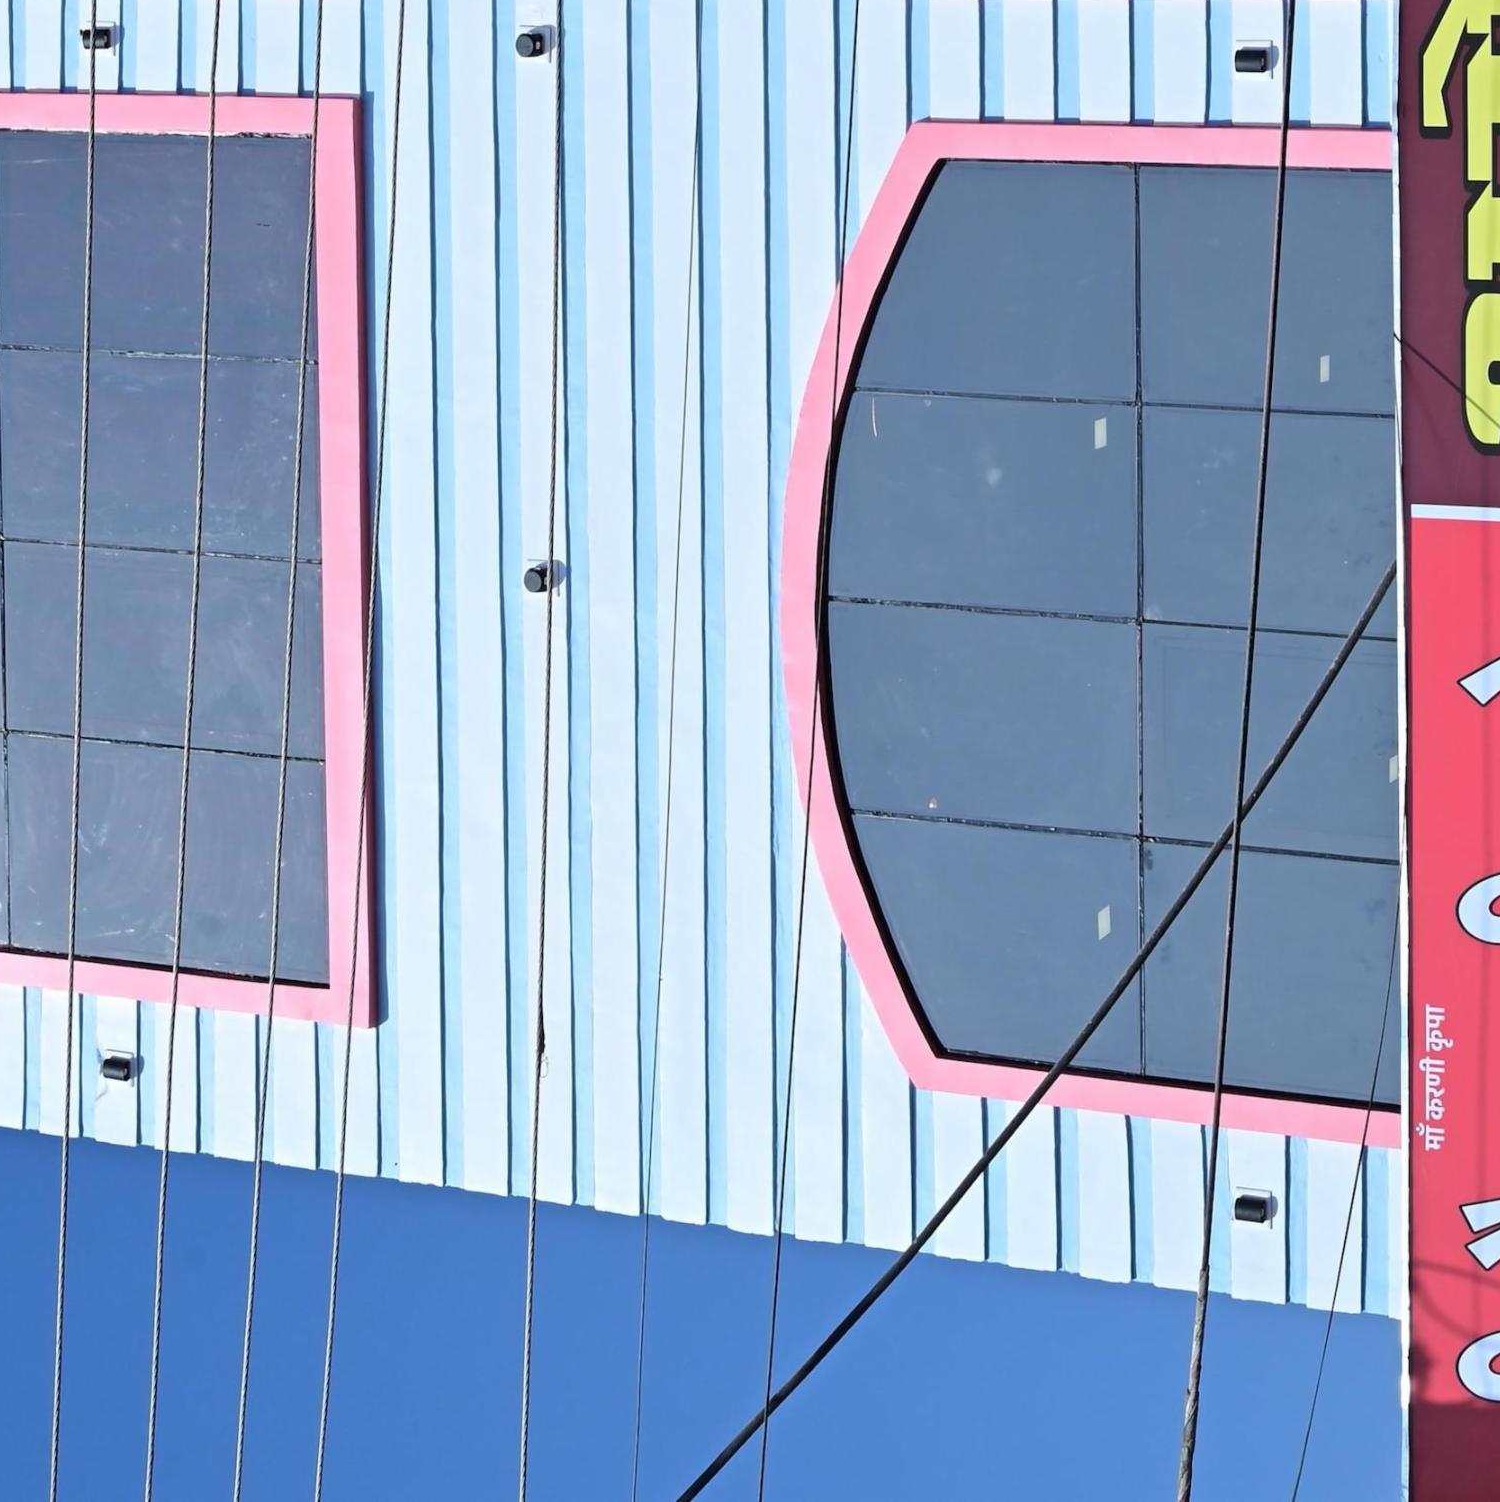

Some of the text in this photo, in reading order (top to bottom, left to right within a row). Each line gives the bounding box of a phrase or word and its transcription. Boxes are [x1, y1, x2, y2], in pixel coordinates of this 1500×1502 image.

[1415, 1003, 1454, 1151] माँ करणी कृपा
